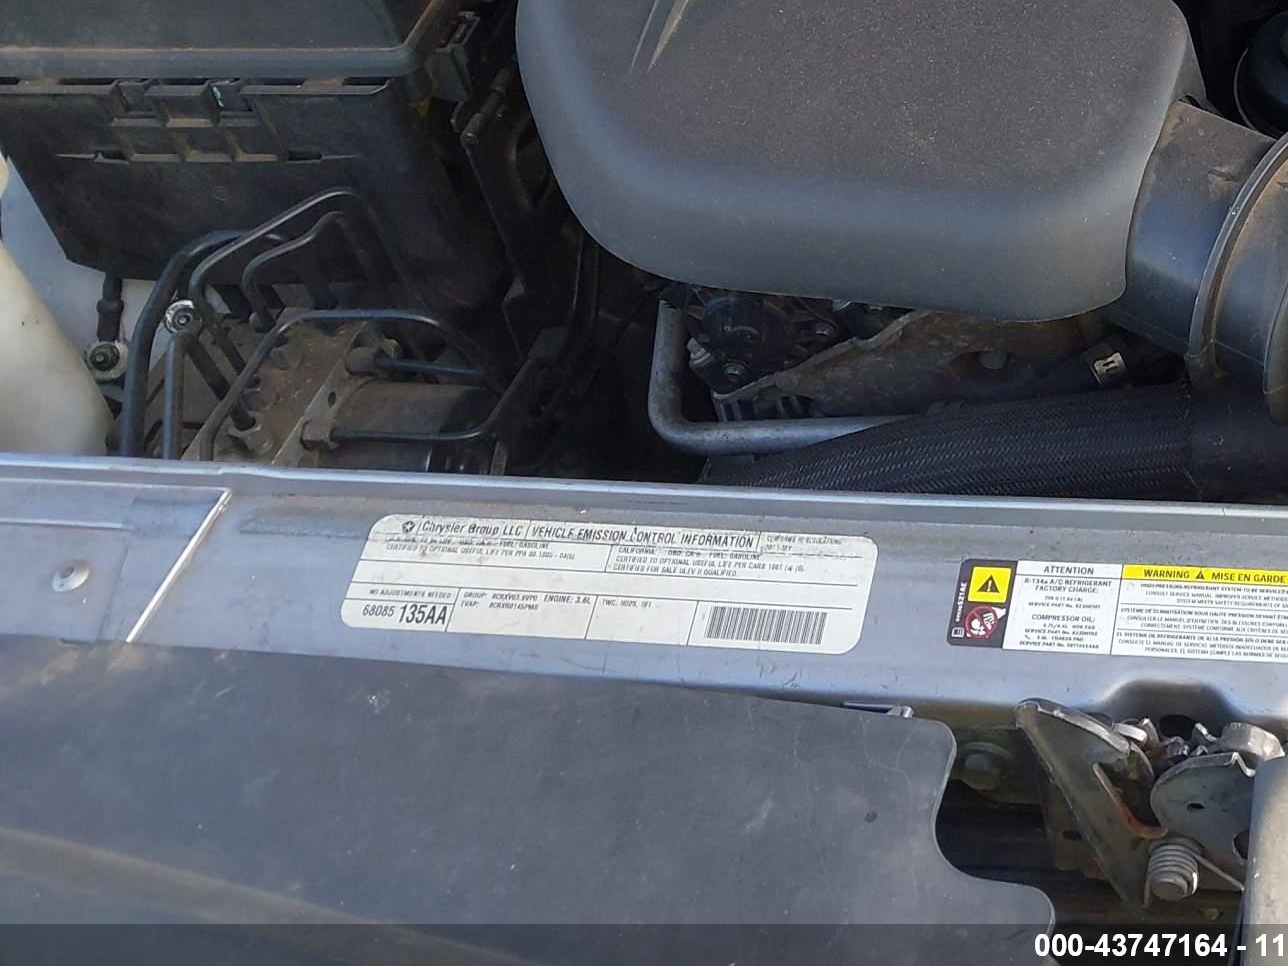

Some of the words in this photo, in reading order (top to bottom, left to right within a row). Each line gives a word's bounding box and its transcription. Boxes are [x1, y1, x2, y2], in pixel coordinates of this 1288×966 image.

[422, 521, 464, 533] Chrysler
[468, 524, 499, 536] Group
[503, 525, 522, 536] LLC
[532, 527, 573, 539] VEHICLE
[577, 529, 626, 542] EMISSION
[631, 532, 677, 544] CONTROL
[681, 534, 754, 548] INFORMATION
[1043, 566, 1095, 575] ATTENTION
[1143, 569, 1190, 579] WARNING
[1211, 571, 1235, 582] MISE
[1237, 572, 1251, 582] EN
[1253, 574, 1286, 584] GARDE
[1065, 579, 1112, 587] REFRIGERANT
[1035, 585, 1067, 593] FACTORY
[543, 594, 574, 604] ENGINE:
[574, 596, 592, 604] 3.6L
[362, 604, 396, 618] 68085
[398, 603, 448, 625] 135AA
[1031, 614, 1080, 622] COMPRESSOR
